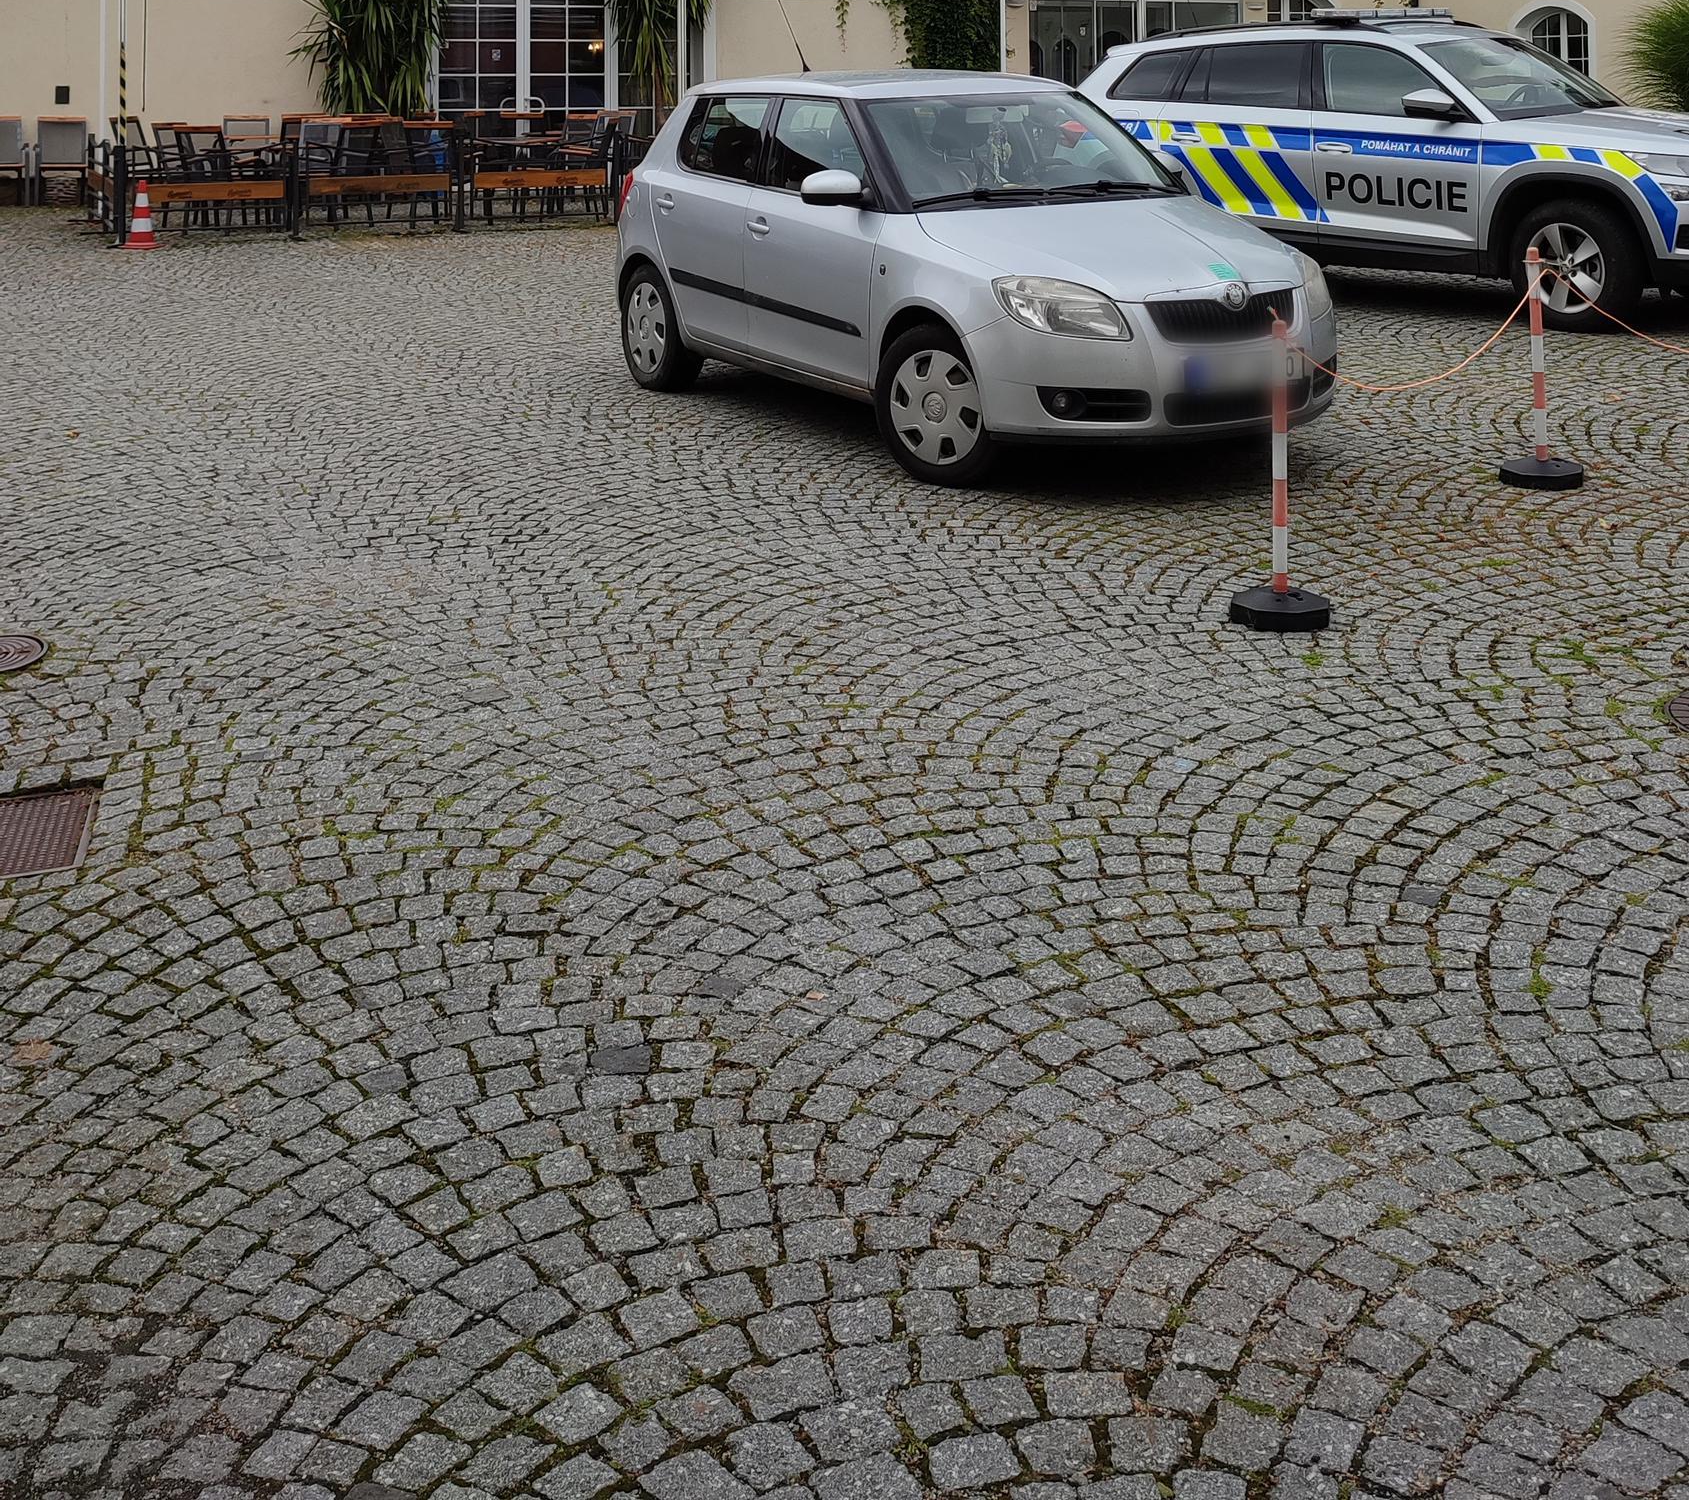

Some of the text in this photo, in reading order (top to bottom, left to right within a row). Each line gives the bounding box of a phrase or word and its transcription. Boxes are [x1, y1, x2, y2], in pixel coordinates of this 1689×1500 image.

[1361, 139, 1471, 157] POMÁHAT A CHRÁNIT
[1325, 171, 1468, 213] POLICIE
